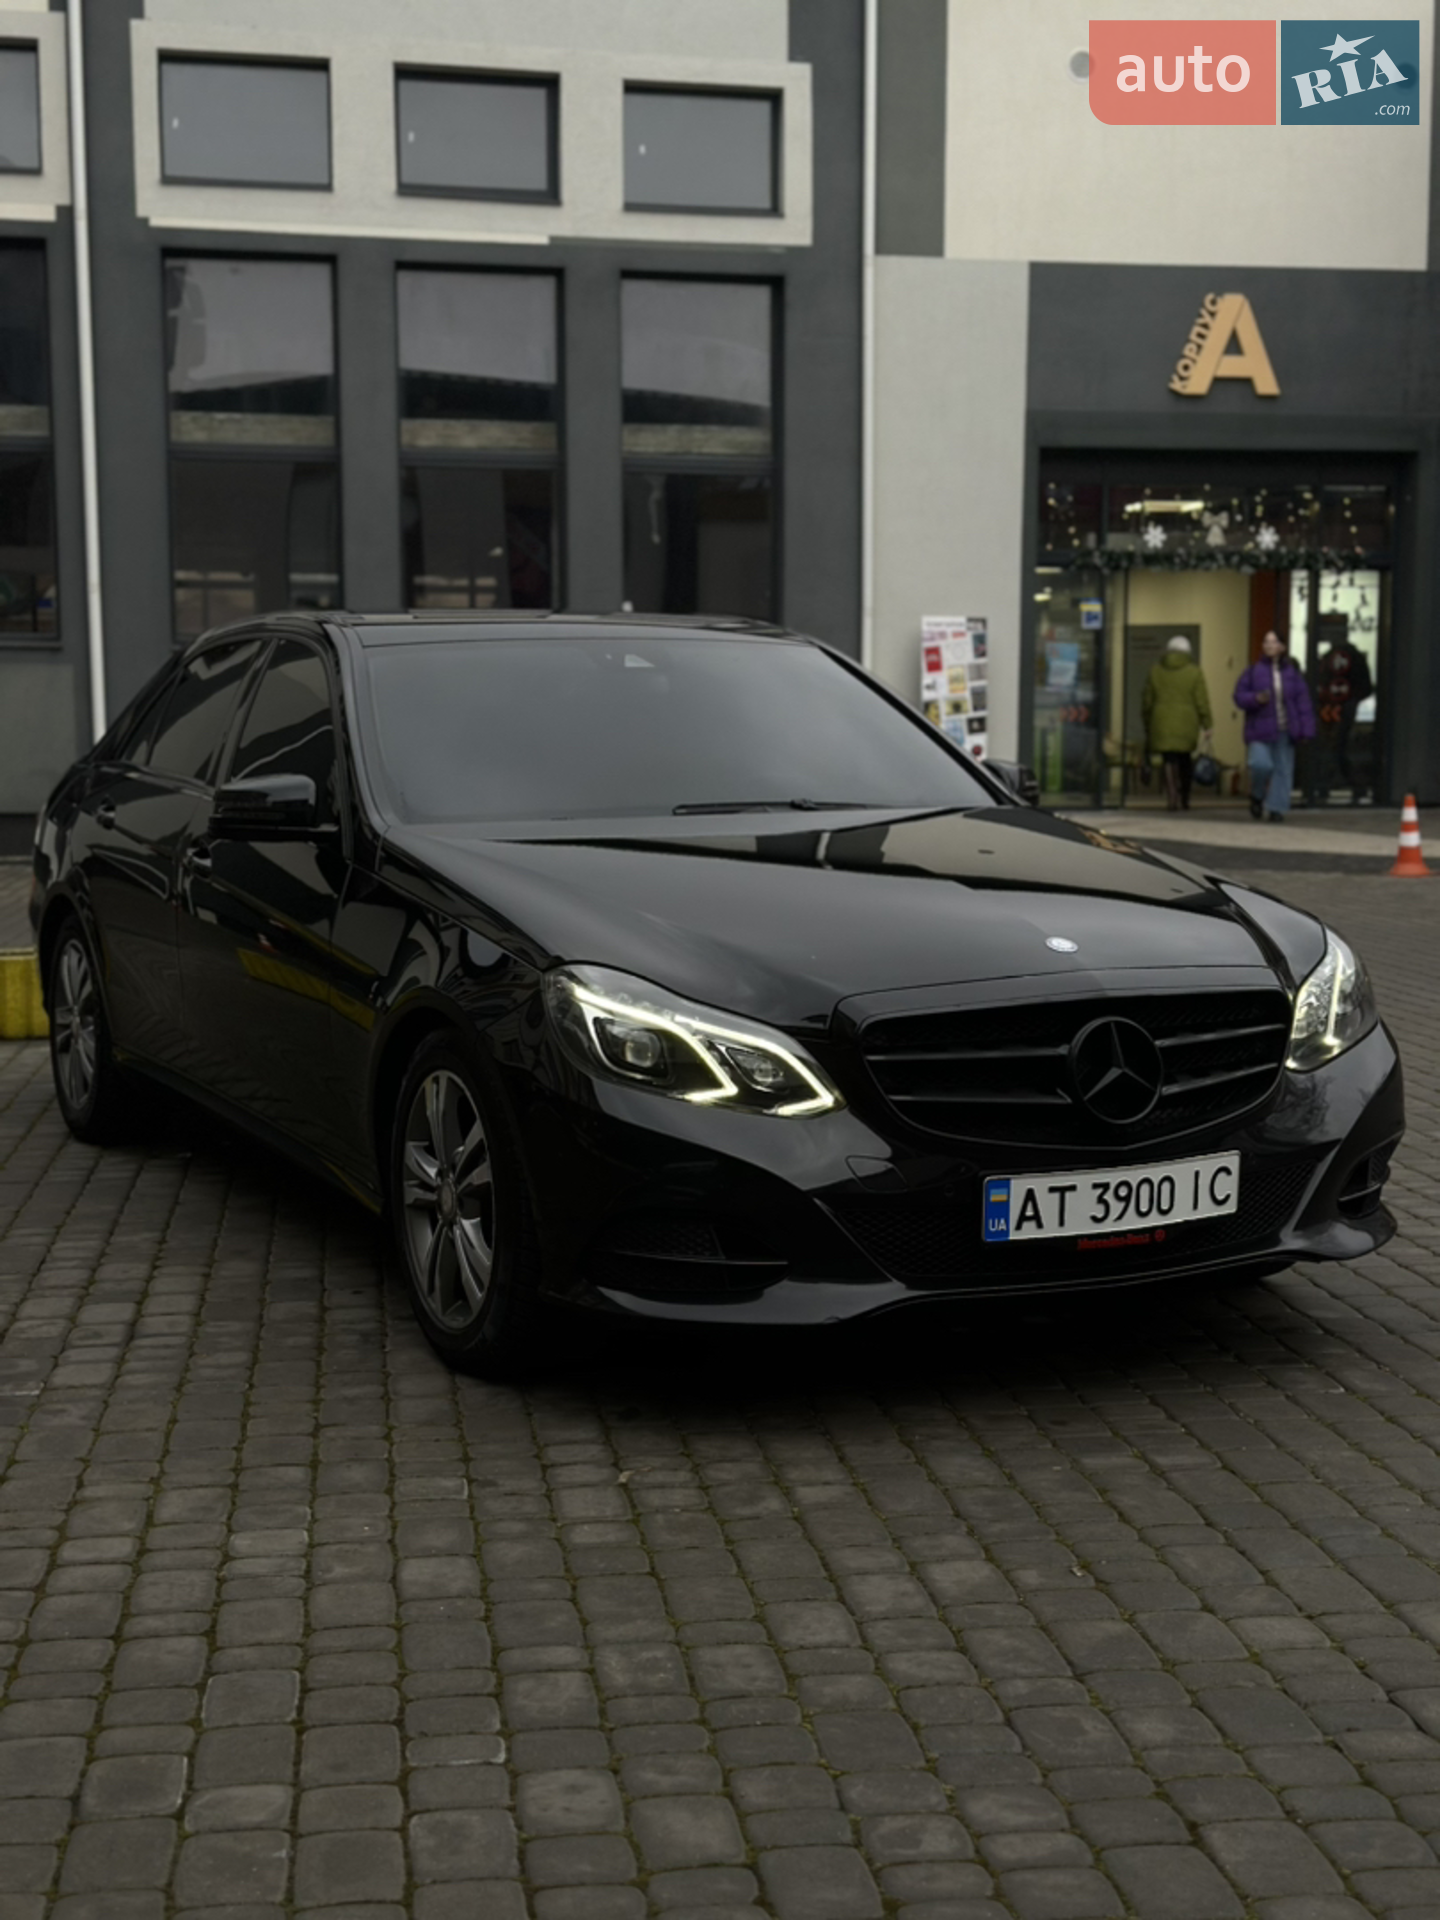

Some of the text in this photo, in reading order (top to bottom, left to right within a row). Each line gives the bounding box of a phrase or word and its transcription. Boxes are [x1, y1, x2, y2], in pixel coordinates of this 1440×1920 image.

[1014, 1165, 1233, 1231] AT 3900 IC
[988, 1218, 1007, 1232] UA
